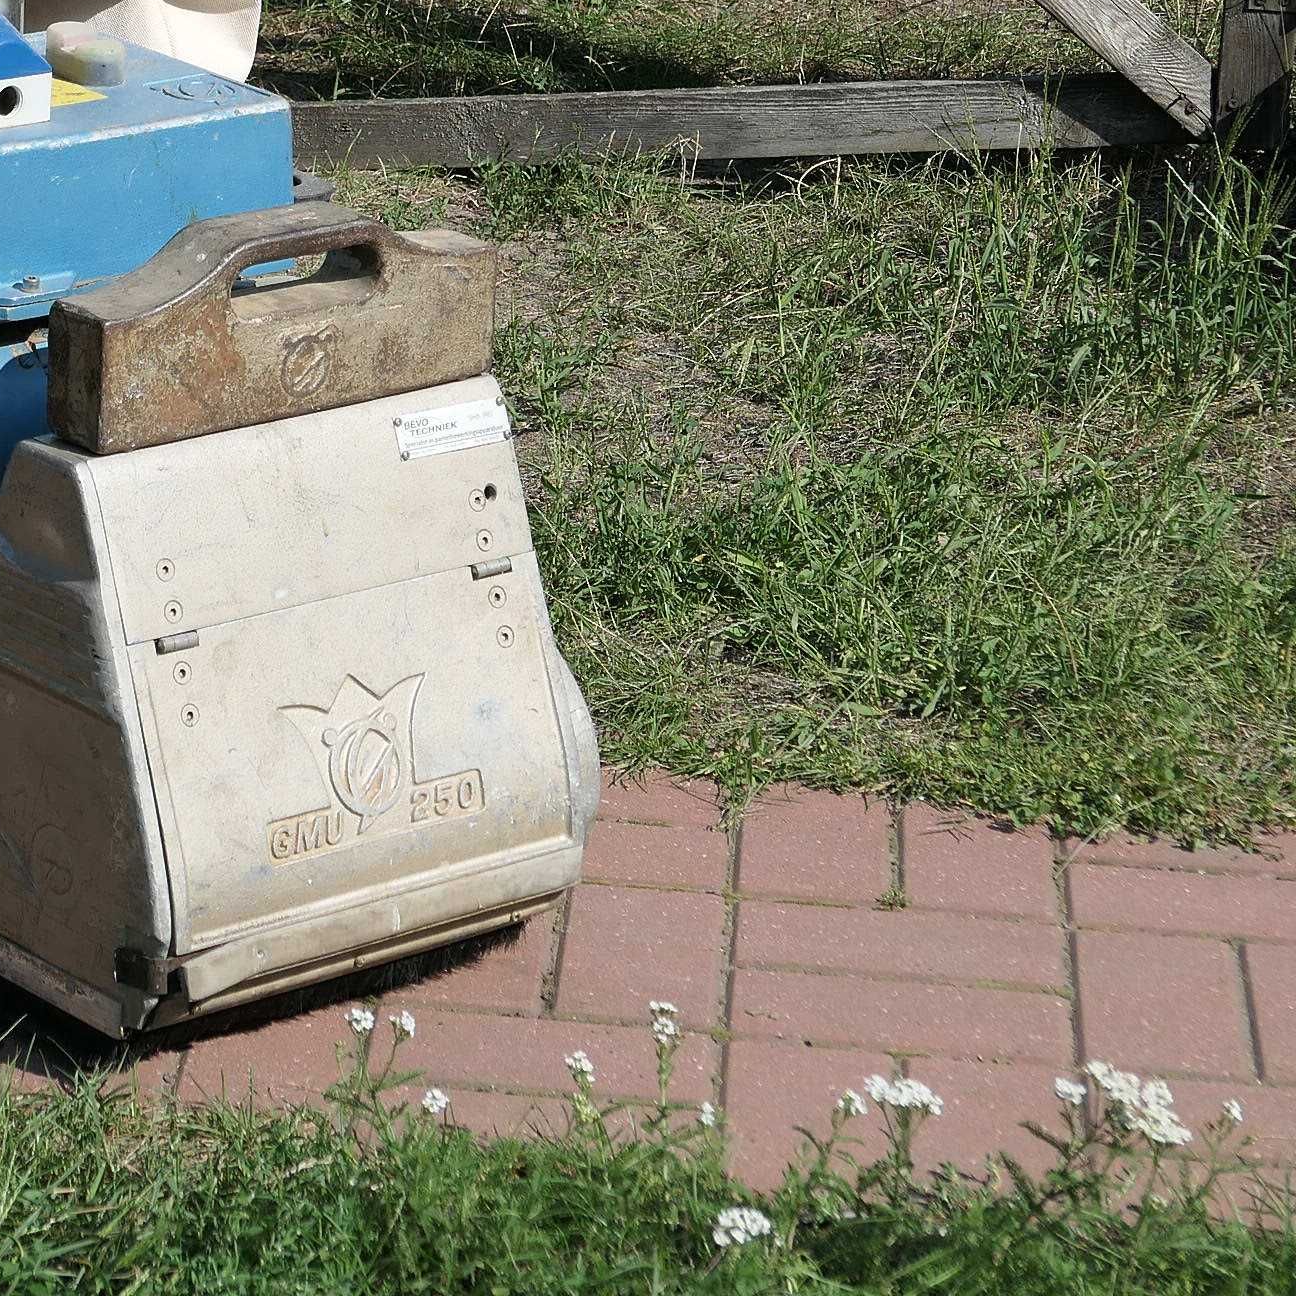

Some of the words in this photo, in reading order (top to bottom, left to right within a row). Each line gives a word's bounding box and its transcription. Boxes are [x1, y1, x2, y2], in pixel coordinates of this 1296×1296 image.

[404, 418, 429, 431] BEVO
[410, 422, 457, 436] TECHNIEK
[271, 811, 344, 860] GMU
[410, 780, 473, 822] 250
